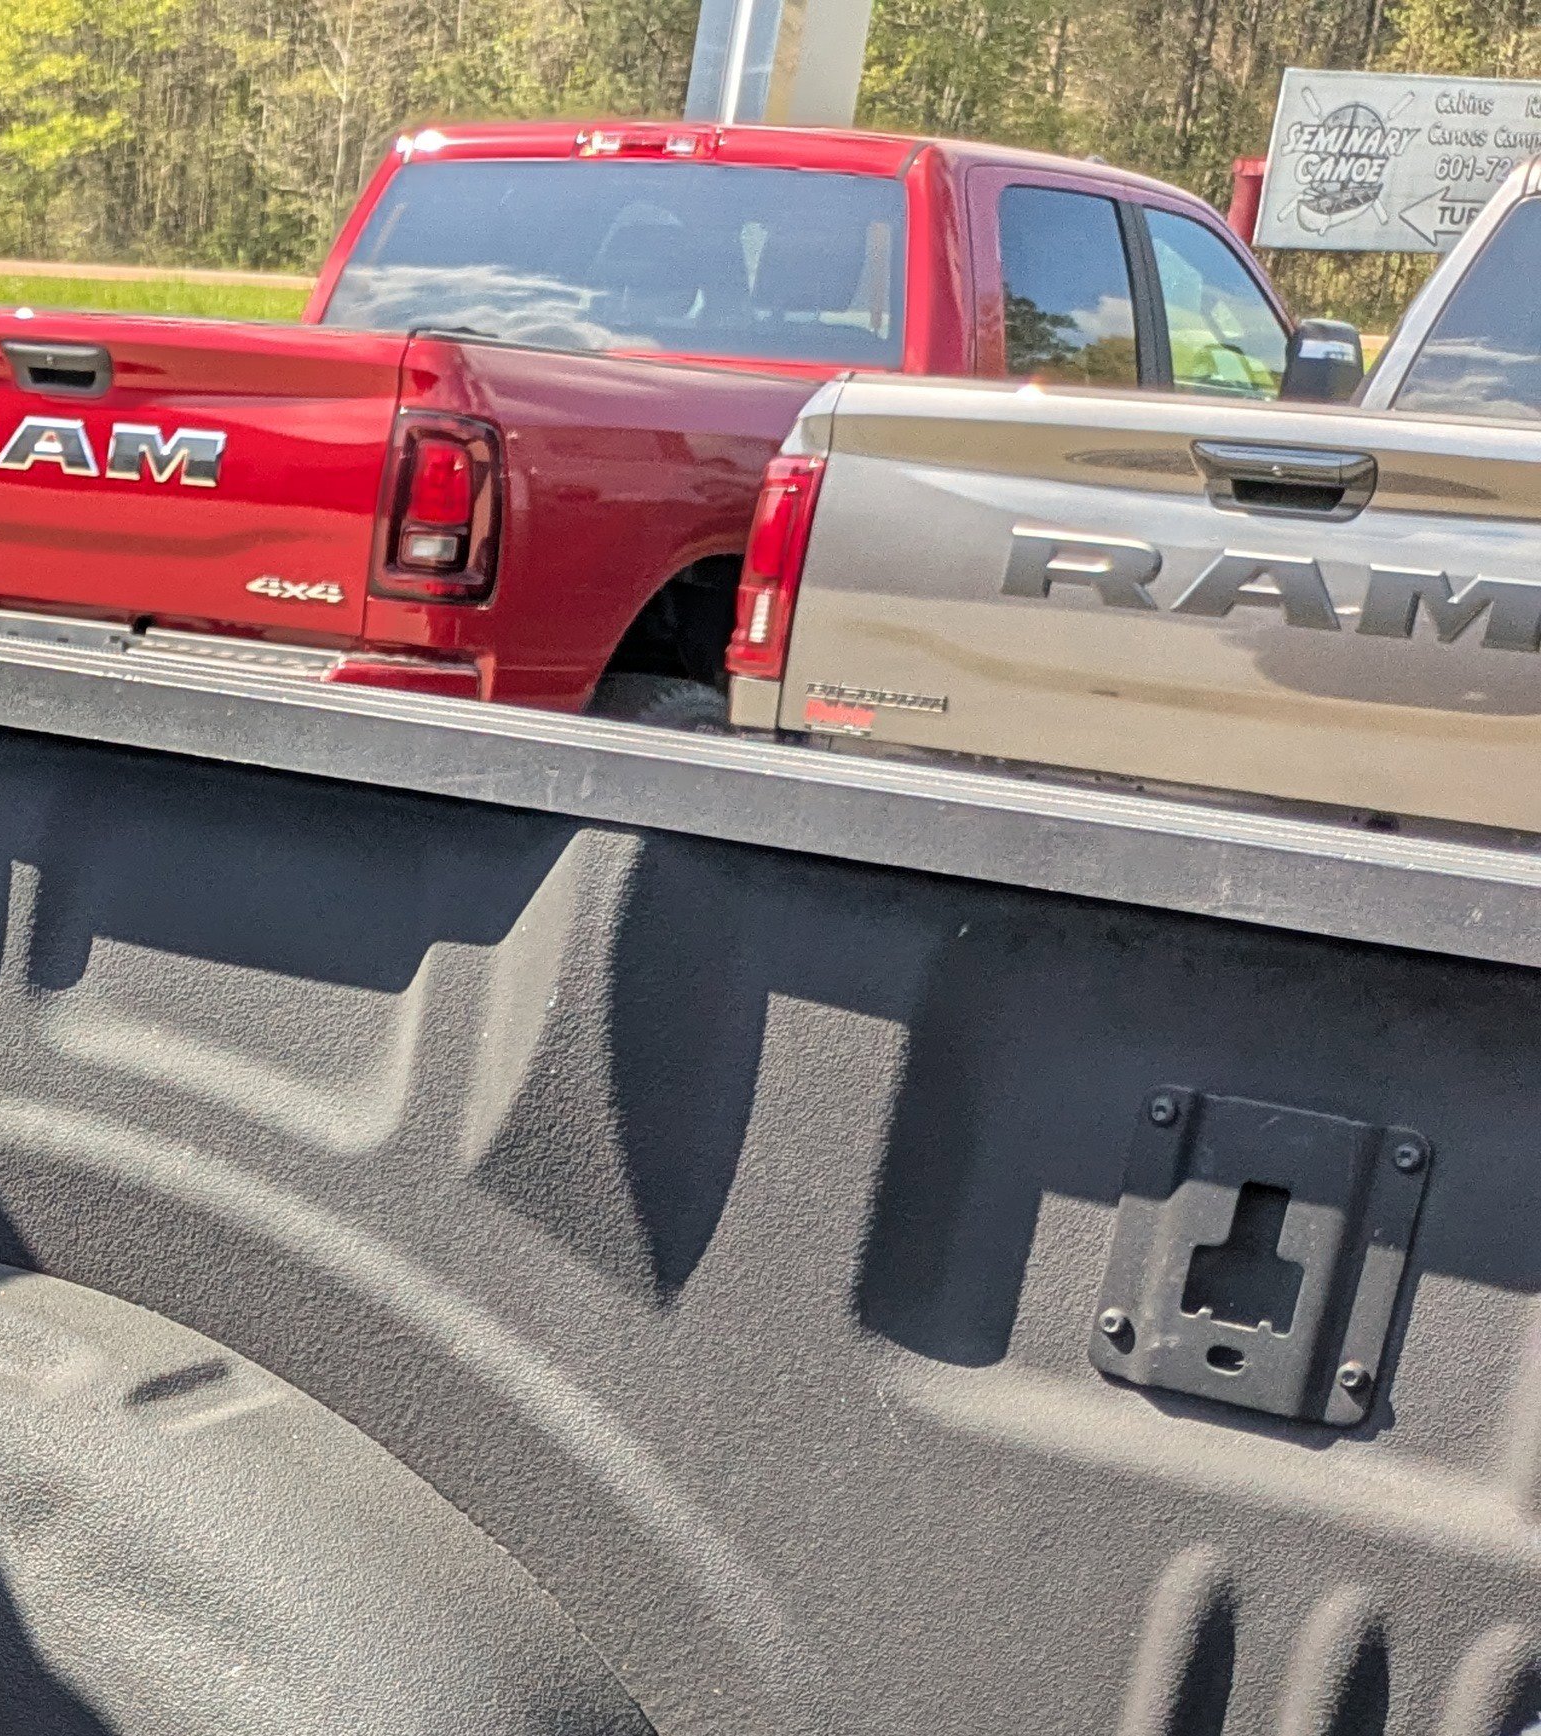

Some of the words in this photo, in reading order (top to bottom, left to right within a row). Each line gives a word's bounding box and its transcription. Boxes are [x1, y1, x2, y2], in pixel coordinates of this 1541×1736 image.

[1435, 89, 1495, 116] Cabins
[1281, 121, 1422, 156] SEMINARY
[1428, 121, 1488, 147] Canoes
[1295, 151, 1389, 185] CANOE
[1000, 525, 1541, 653] RAM
